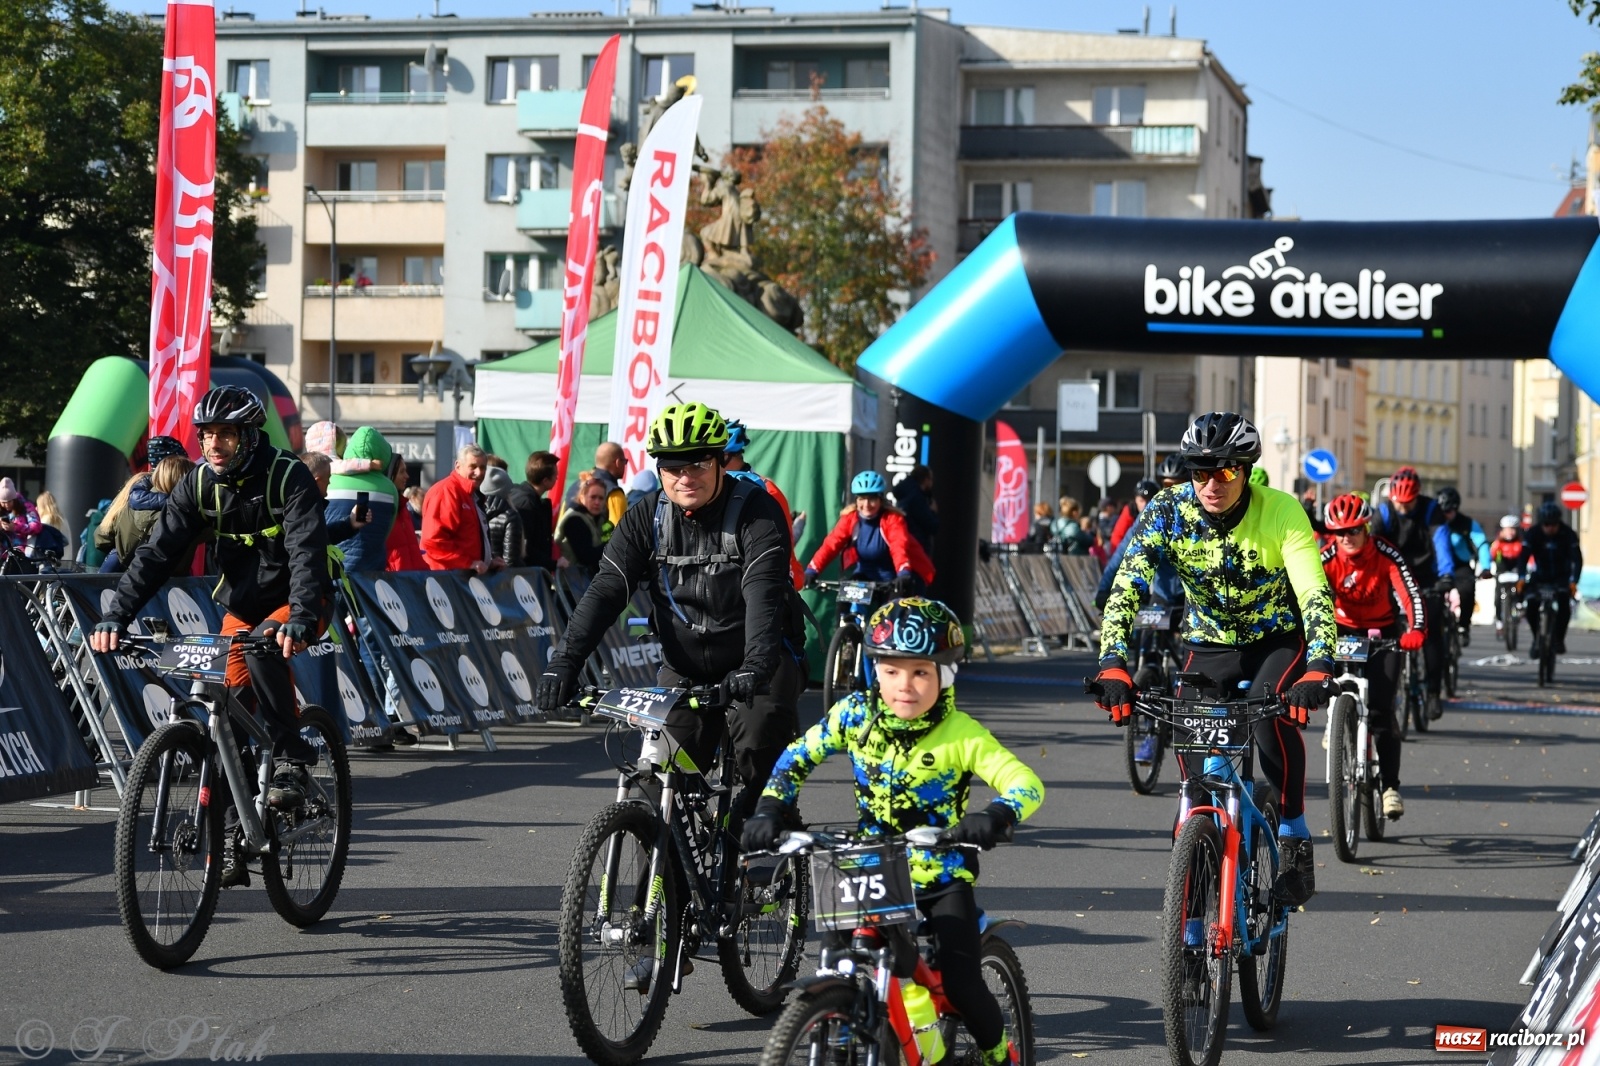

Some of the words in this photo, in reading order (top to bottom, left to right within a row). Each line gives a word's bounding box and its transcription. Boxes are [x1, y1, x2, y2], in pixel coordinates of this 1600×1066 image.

[1144, 264, 1256, 317] bike
[1270, 268, 1444, 320] atelier
[622, 149, 679, 485] RACIBÓRZ
[1141, 614, 1162, 625] 299
[173, 645, 219, 656] OPIEKUN
[177, 653, 212, 670] 298
[619, 687, 667, 703] OPIEKUN
[616, 695, 653, 716] 121
[1184, 718, 1237, 728] OPIEKUN
[1194, 727, 1229, 745] 175
[0, 731, 45, 777] LYCH
[838, 873, 886, 902] 175
